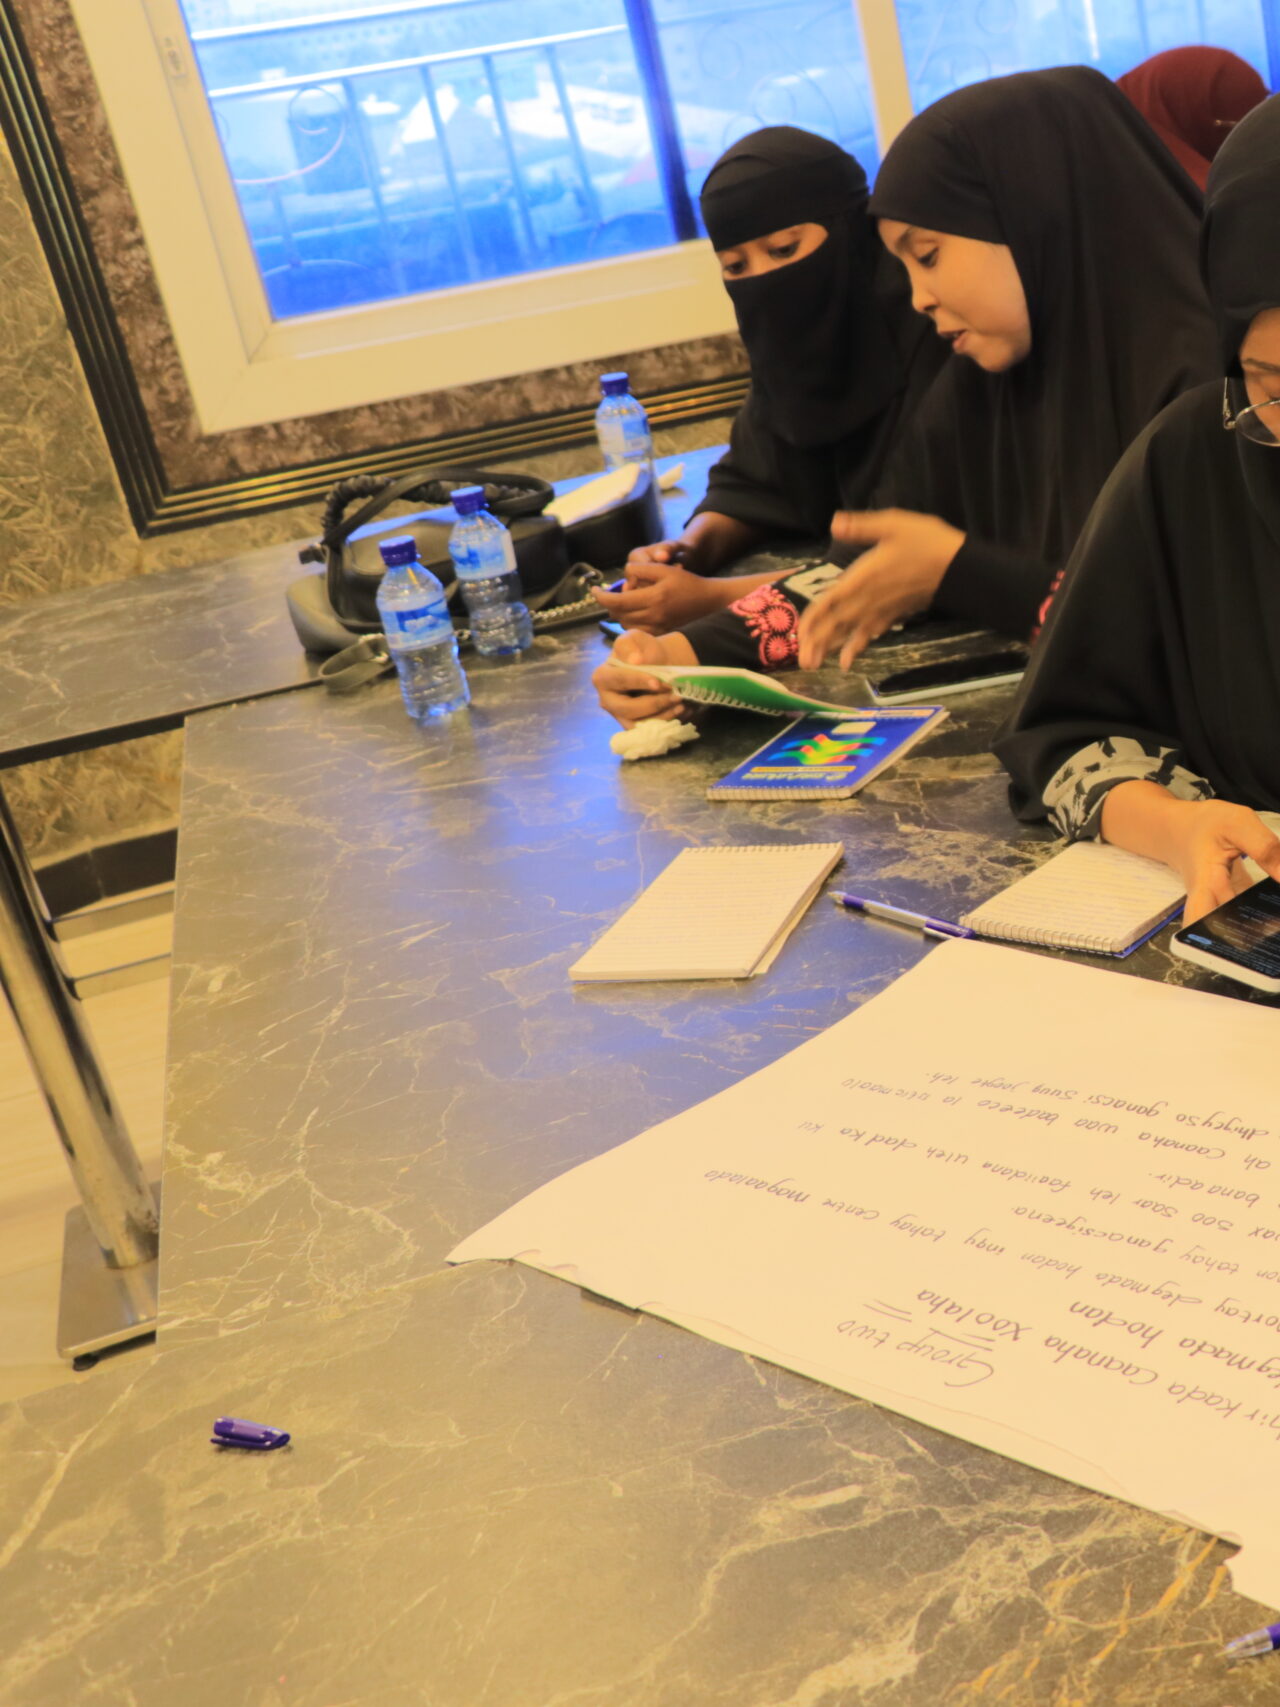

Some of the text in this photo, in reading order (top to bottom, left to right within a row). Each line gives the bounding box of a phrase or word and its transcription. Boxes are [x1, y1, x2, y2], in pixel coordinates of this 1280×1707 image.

[1082, 1094, 1169, 1118] ganacsi
[1074, 1118, 1119, 1135] waa
[1243, 1153, 1271, 1170] ah
[1089, 1187, 1120, 1205] leh
[890, 1214, 946, 1242] tahay
[1179, 1245, 1239, 1275] tahay
[1069, 1302, 1163, 1349] hodan
[836, 1318, 994, 1388] Group two
